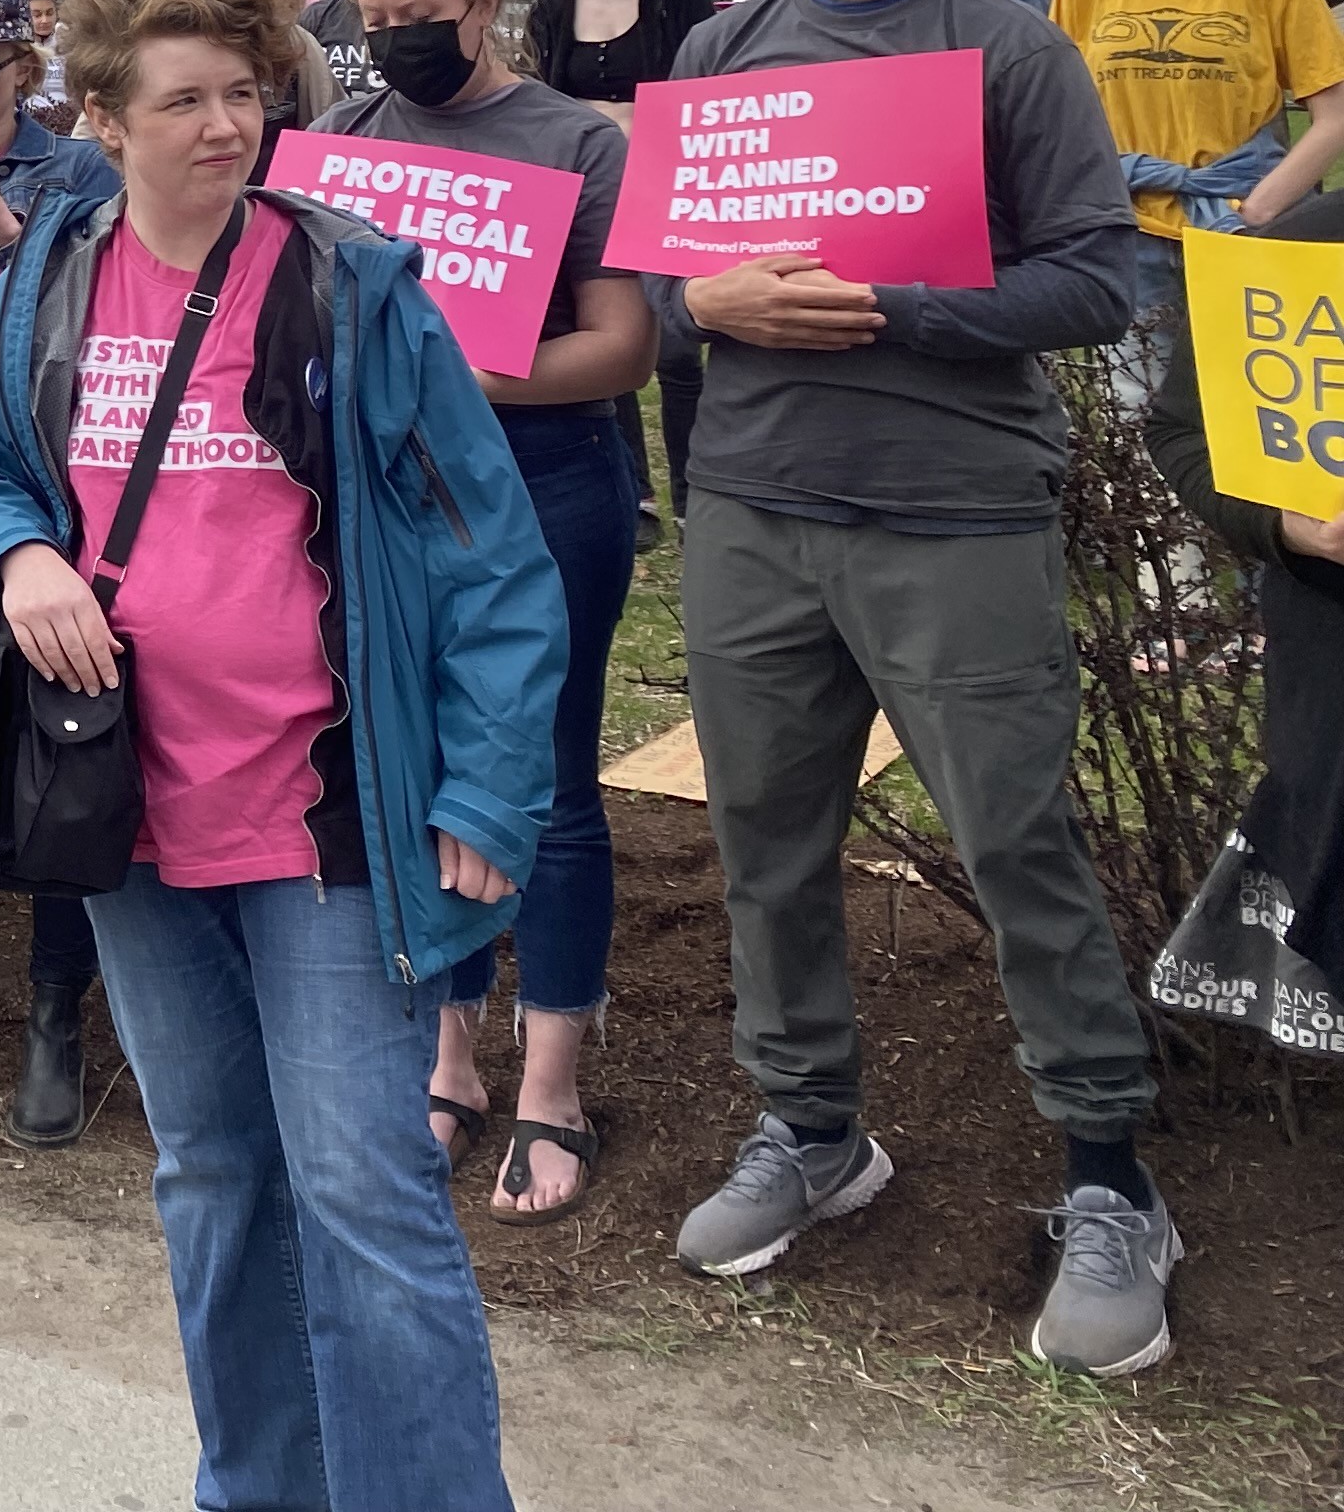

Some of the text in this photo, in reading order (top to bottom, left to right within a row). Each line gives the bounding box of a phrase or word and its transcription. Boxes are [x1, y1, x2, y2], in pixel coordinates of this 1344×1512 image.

[323, 45, 373, 64] AN
[332, 67, 362, 87] FF
[1132, 67, 1183, 80] TREAD
[1187, 68, 1209, 80] ON
[1214, 70, 1239, 83] ME
[681, 90, 814, 128] I STAND
[680, 128, 770, 159] WITH
[319, 154, 512, 211] PROTECT
[674, 156, 838, 191] PLANNED
[397, 204, 533, 258] LEGAL
[679, 238, 738, 254] Planned
[95, 340, 174, 366] STAN
[77, 373, 149, 396] WITH
[75, 403, 204, 430] PLANED
[68, 437, 278, 465] PARETHOOD
[1155, 949, 1215, 979] ANS
[1198, 979, 1258, 1000] OUR
[1275, 978, 1329, 1011] ANS
[1271, 1017, 1344, 1053] BODIE
